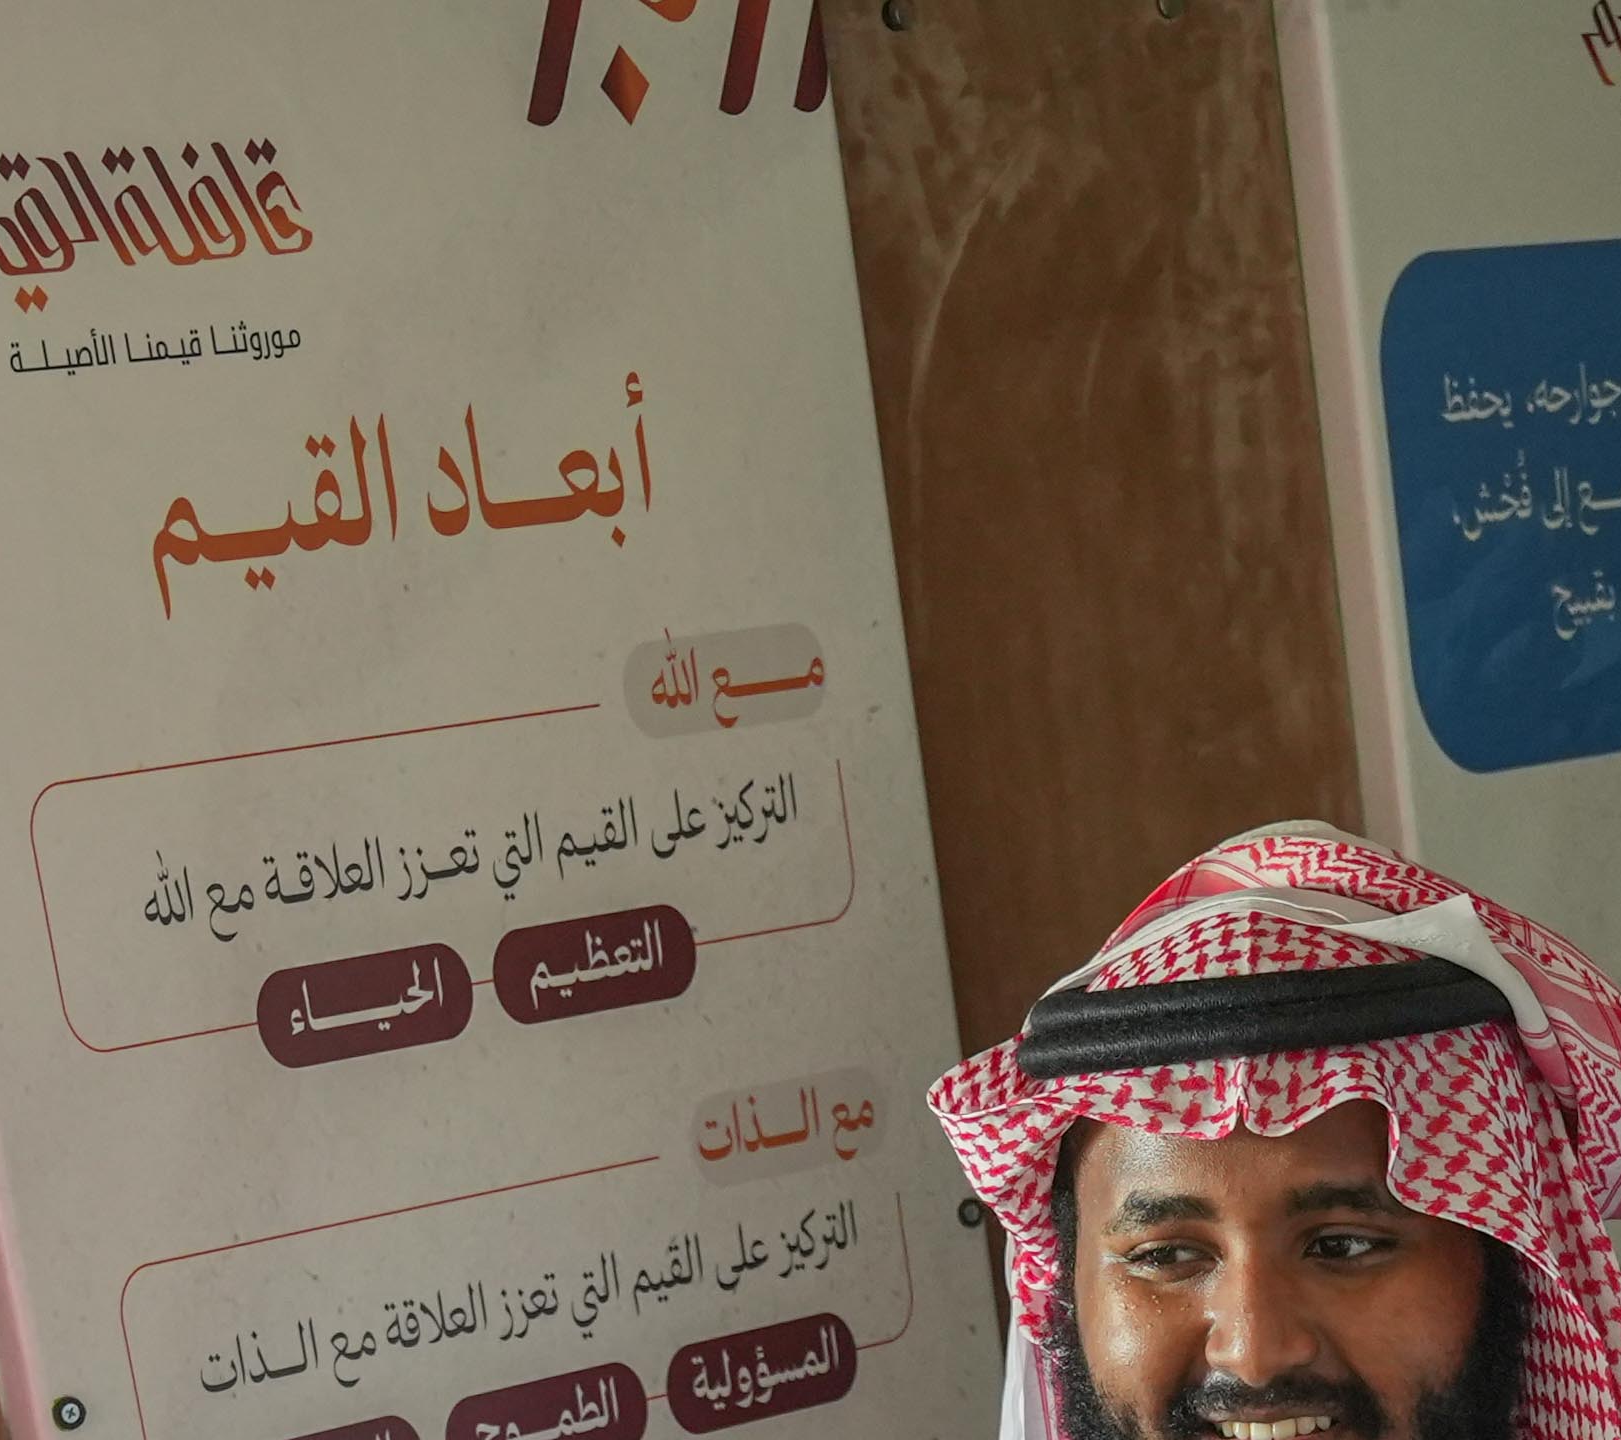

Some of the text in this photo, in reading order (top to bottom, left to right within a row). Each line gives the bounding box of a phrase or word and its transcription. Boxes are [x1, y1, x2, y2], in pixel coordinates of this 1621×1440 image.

[9, 320, 302, 376] موروثنا قيمنا الأصيلة
[152, 371, 652, 621] أبعاد القيم
[650, 626, 826, 729] مع الله
[143, 772, 797, 942] التركيز على القيم التي تعزز العلاقة مع الله
[289, 918, 665, 1038] التعظيم الحياء
[697, 1086, 876, 1163] مع الذات
[200, 1199, 859, 1395] التركيز على القيم التي تعزز العلاقة مع الذات
[691, 1325, 840, 1411] المسؤولية
